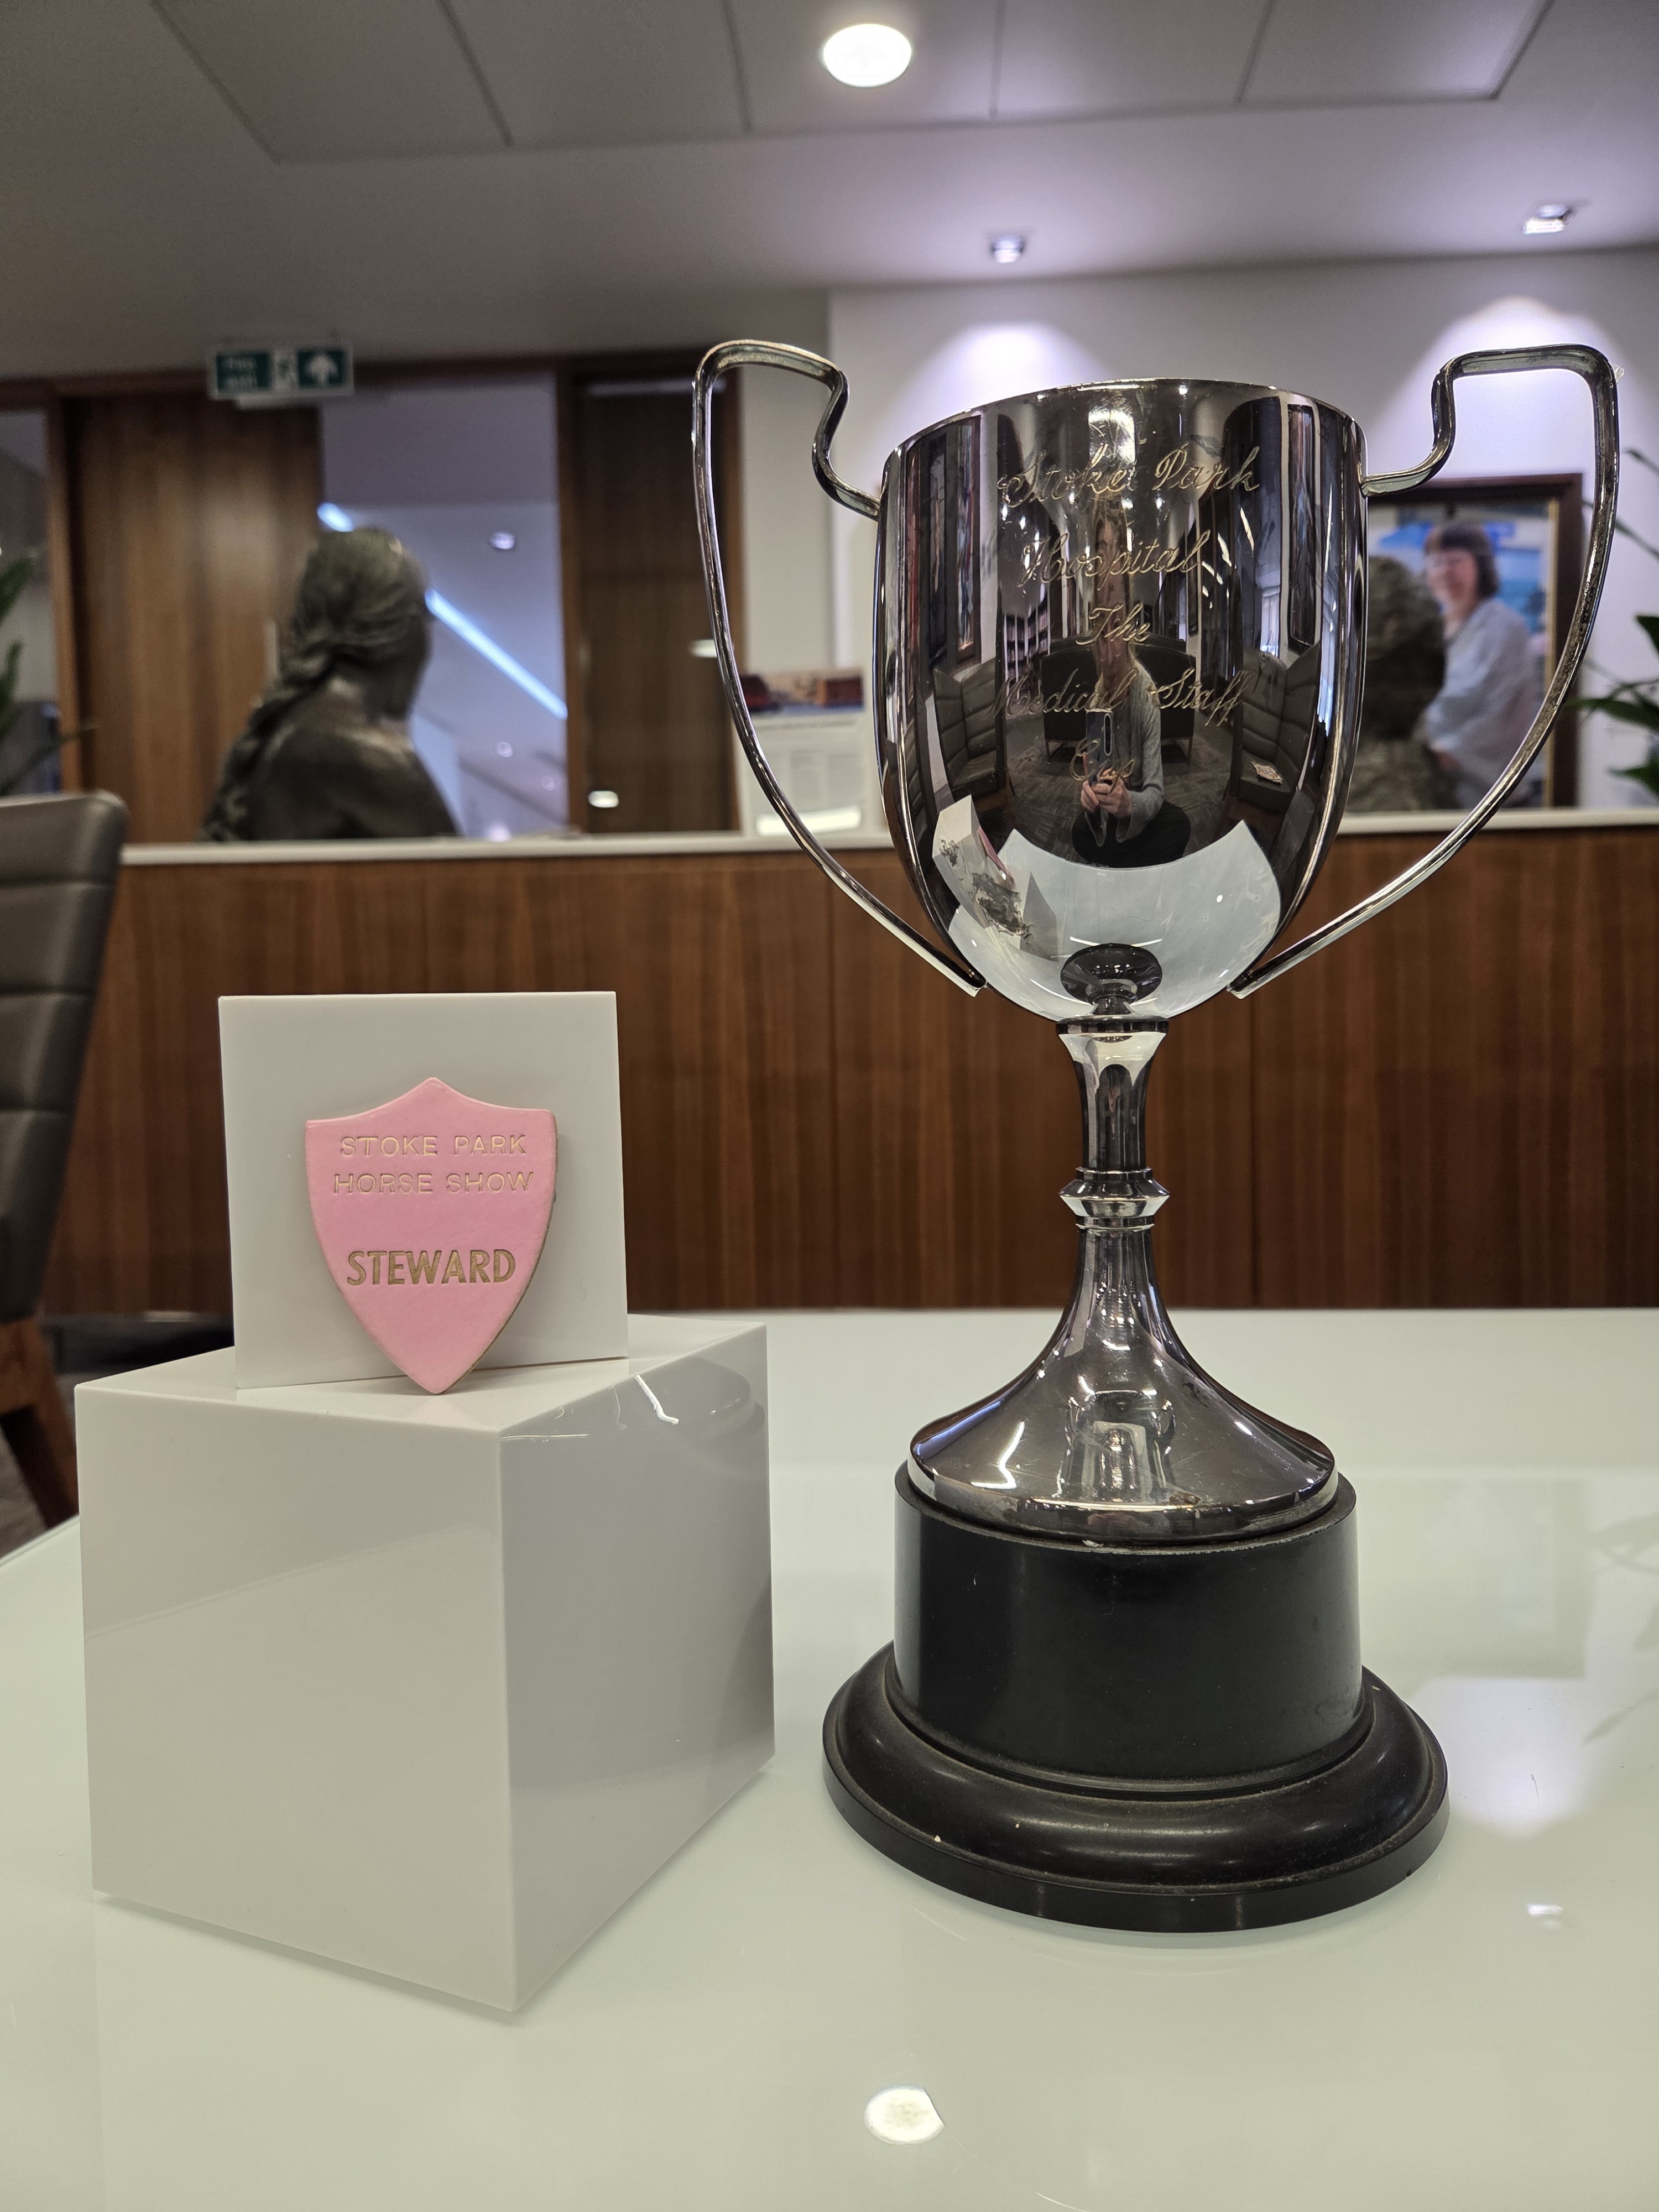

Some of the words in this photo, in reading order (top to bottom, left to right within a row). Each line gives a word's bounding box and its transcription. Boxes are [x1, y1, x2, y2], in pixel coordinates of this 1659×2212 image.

[1152, 442, 1260, 492] Park
[1018, 529, 1211, 591] Hospital
[1076, 603, 1151, 645] The
[983, 667, 1139, 719] Medical
[1147, 667, 1255, 727] Staff
[340, 1135, 439, 1157] STOKE
[453, 1134, 527, 1156] PARK
[333, 1173, 434, 1194] HORSE
[446, 1171, 534, 1193] SHOW
[347, 1249, 517, 1286] STEWARD
